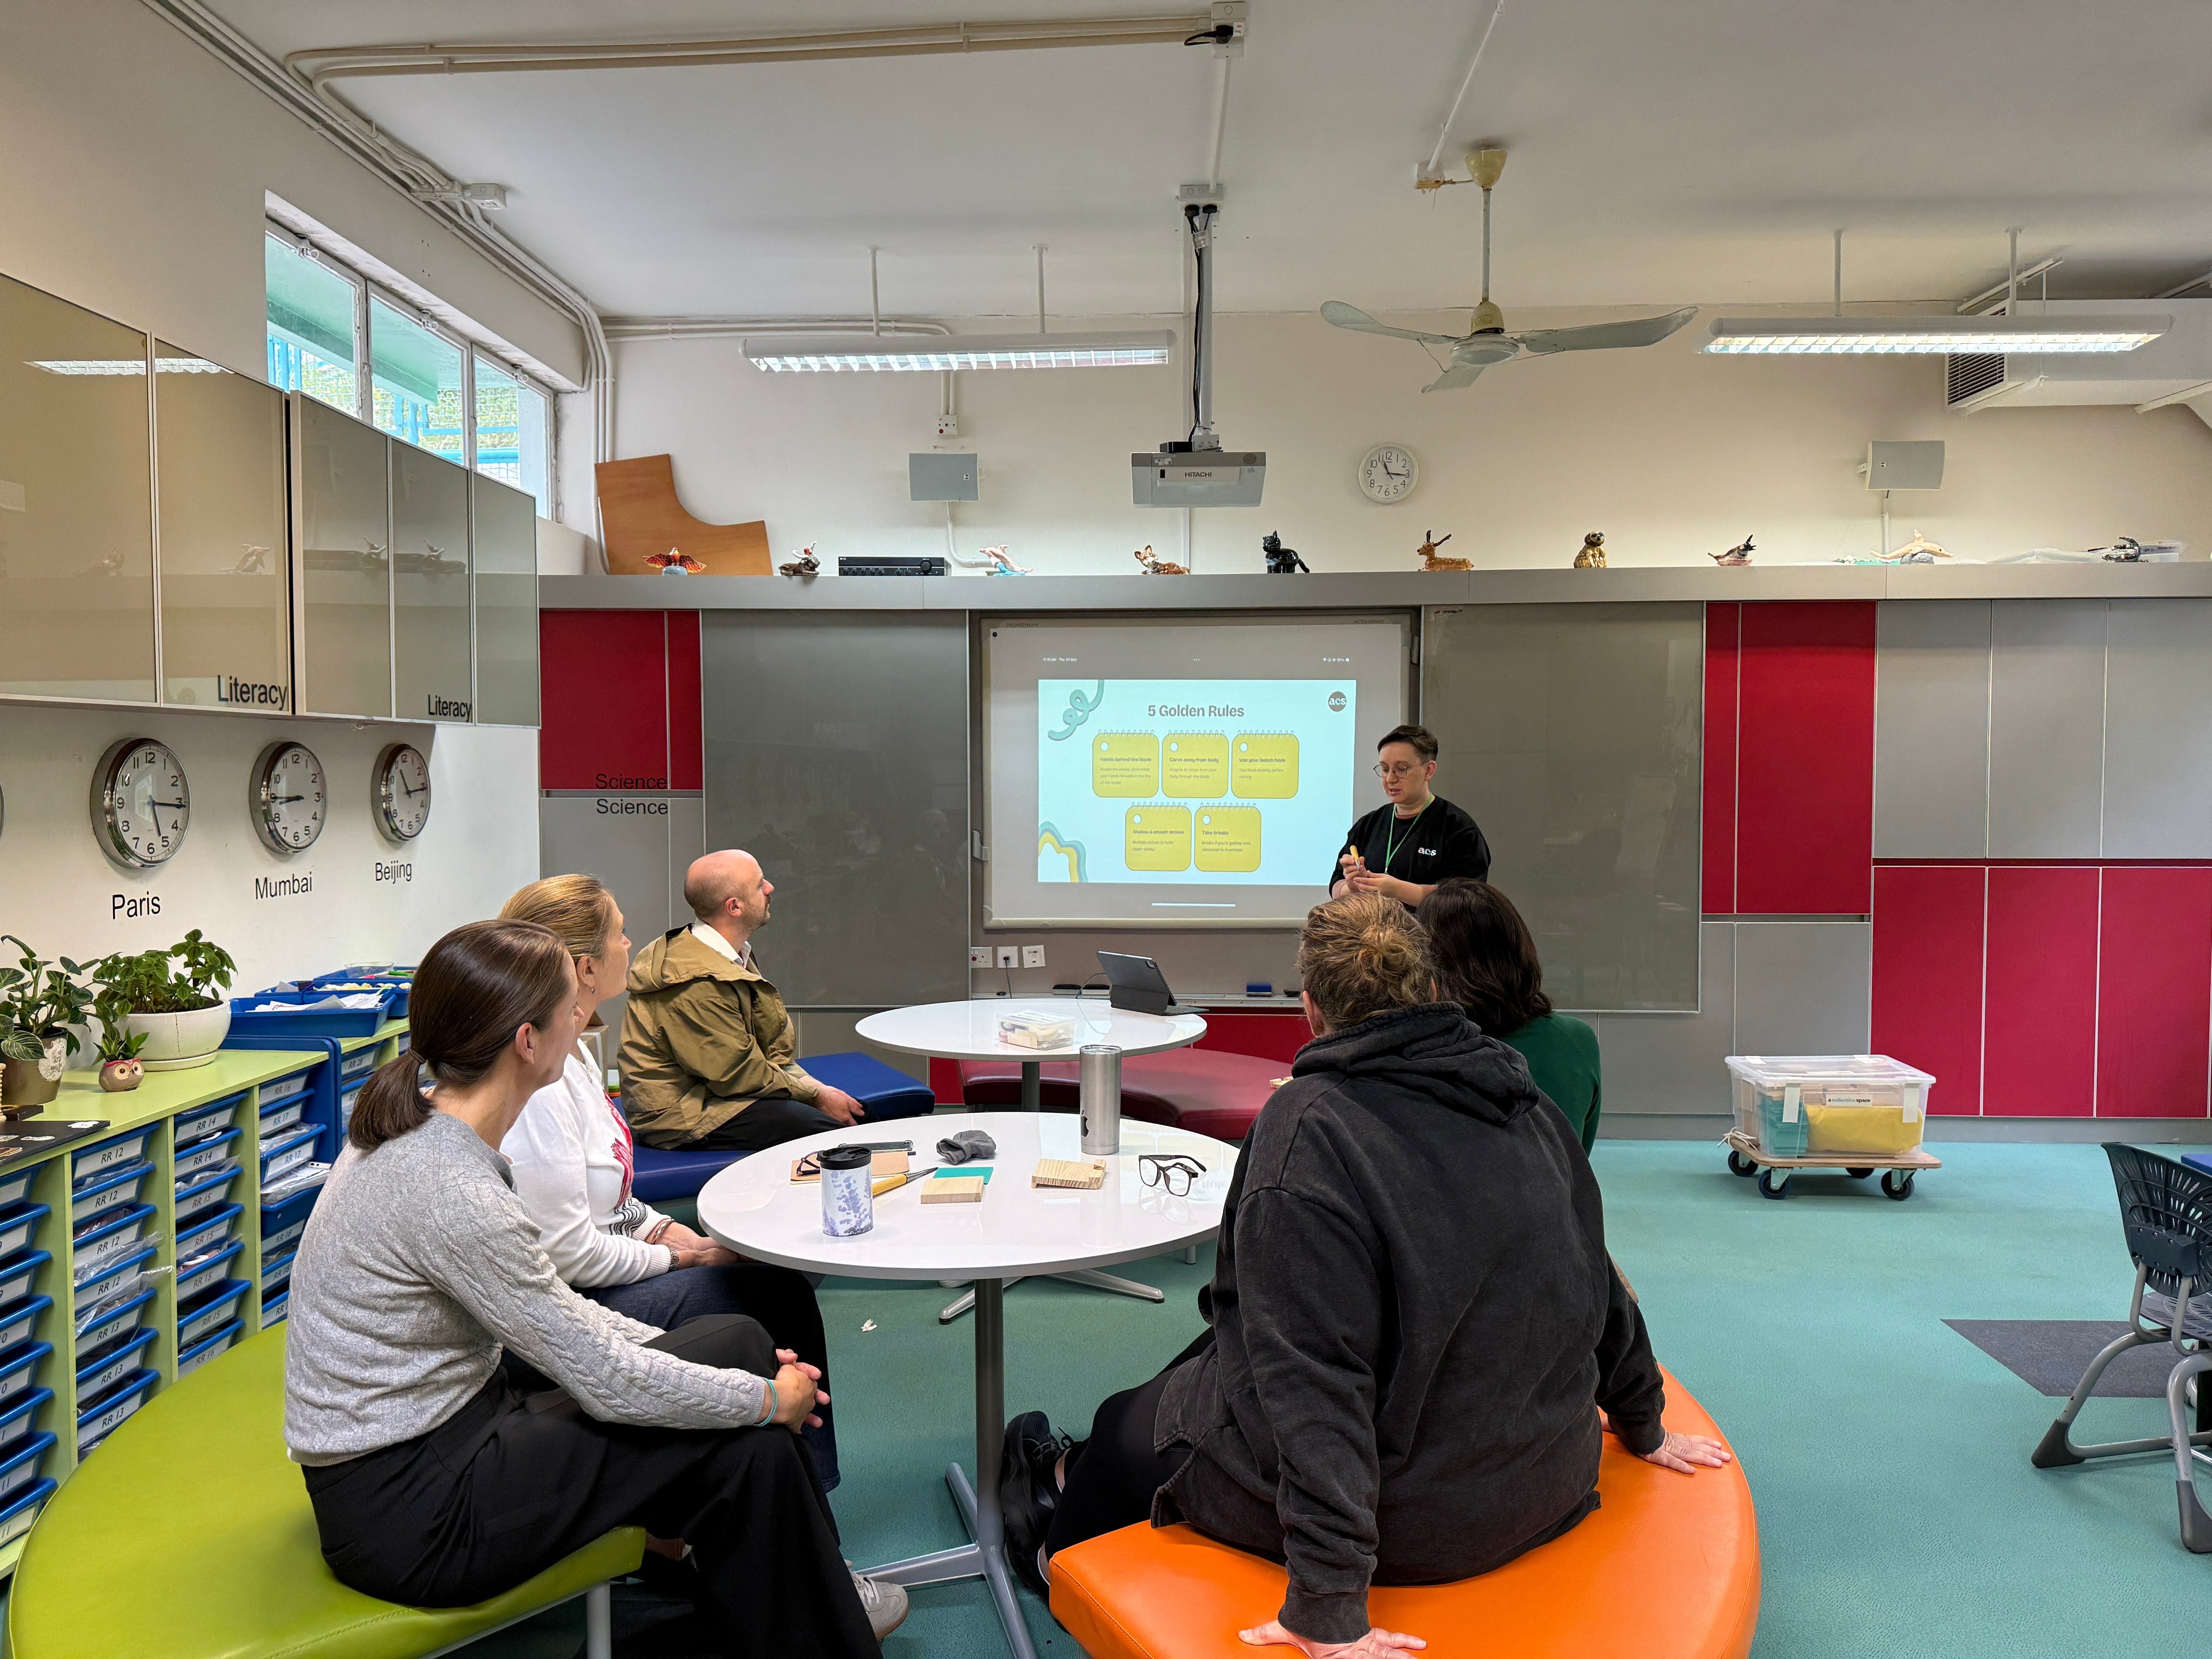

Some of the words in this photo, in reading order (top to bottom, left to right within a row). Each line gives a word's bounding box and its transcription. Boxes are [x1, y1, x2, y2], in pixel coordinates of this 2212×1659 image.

[1385, 451, 1392, 460] 12
[1370, 459, 1377, 468] 10
[1402, 459, 1407, 468] 2
[1367, 469, 1372, 478] 9
[1405, 469, 1410, 478] 3
[1370, 479, 1375, 488] 8
[1400, 480, 1406, 488] 4
[1377, 485, 1382, 494] 7
[1384, 487, 1390, 496] 6
[1393, 486, 1399, 494] 5
[217, 675, 287, 711] Literacy
[427, 694, 472, 721] Literacy
[1329, 698, 1346, 706] acs
[1148, 705, 1156, 717] 5
[1159, 704, 1205, 717] Golden
[1209, 704, 1244, 717] Rules
[133, 757, 139, 769] 11
[145, 752, 156, 764] 12
[282, 758, 287, 769] 11
[291, 754, 300, 764] 12
[401, 754, 407, 763] 12
[417, 767, 422, 776] 2
[171, 775, 179, 787] 2
[274, 774, 281, 784] 10
[311, 774, 317, 783] 2
[596, 774, 668, 789] Science
[117, 797, 125, 809] 9
[315, 793, 320, 802] 3
[388, 793, 393, 802] 9
[420, 800, 424, 808] 4
[597, 798, 668, 815] Science
[274, 813, 281, 823] 8
[312, 812, 317, 821] 4
[415, 813, 420, 823] 5
[122, 820, 130, 832] 8
[172, 820, 179, 831] 4
[399, 820, 404, 828] 7
[408, 821, 413, 830] 6
[282, 827, 288, 837] 7
[304, 826, 310, 835] 5
[161, 836, 169, 847] 5
[293, 832, 300, 842] 6
[132, 837, 139, 849] 7
[147, 842, 155, 854] 6
[1418, 847, 1437, 856] acs
[375, 861, 412, 884] Beijing
[255, 871, 312, 900] Mumbai
[112, 891, 161, 920] Paris
[274, 1086, 282, 1095] RR
[196, 1120, 206, 1131] RR
[209, 1117, 216, 1127] 14
[273, 1116, 281, 1126] RR
[283, 1113, 289, 1122] 17
[101, 1152, 111, 1164] RR
[116, 1147, 123, 1158] 12
[194, 1155, 202, 1166] RR
[205, 1152, 212, 1161] 14
[285, 1154, 293, 1164] RR
[295, 1150, 301, 1159] 17
[96, 1196, 106, 1207] RR
[109, 1191, 118, 1201] 12
[192, 1197, 201, 1208] RR
[204, 1194, 211, 1202] 15
[195, 1236, 203, 1247] RR
[207, 1231, 213, 1241] 15
[276, 1234, 283, 1243] RR
[97, 1242, 108, 1254] RR
[111, 1236, 120, 1248] 12
[193, 1277, 203, 1289] RR
[205, 1272, 213, 1282] 15
[273, 1271, 281, 1280] RR
[98, 1282, 109, 1295] RR
[112, 1277, 120, 1288] 12
[276, 1306, 283, 1316] RR
[202, 1316, 211, 1327] RR
[214, 1310, 220, 1320] 15
[97, 1328, 107, 1341] RR
[111, 1322, 120, 1334] 13
[0, 1332, 7, 1343] 0
[196, 1354, 204, 1366] RR
[208, 1349, 214, 1359] 16
[101, 1372, 111, 1385] RR
[115, 1365, 123, 1376] 13
[0, 1382, 7, 1393] 0
[102, 1415, 112, 1428] RR
[116, 1408, 124, 1419] 13
